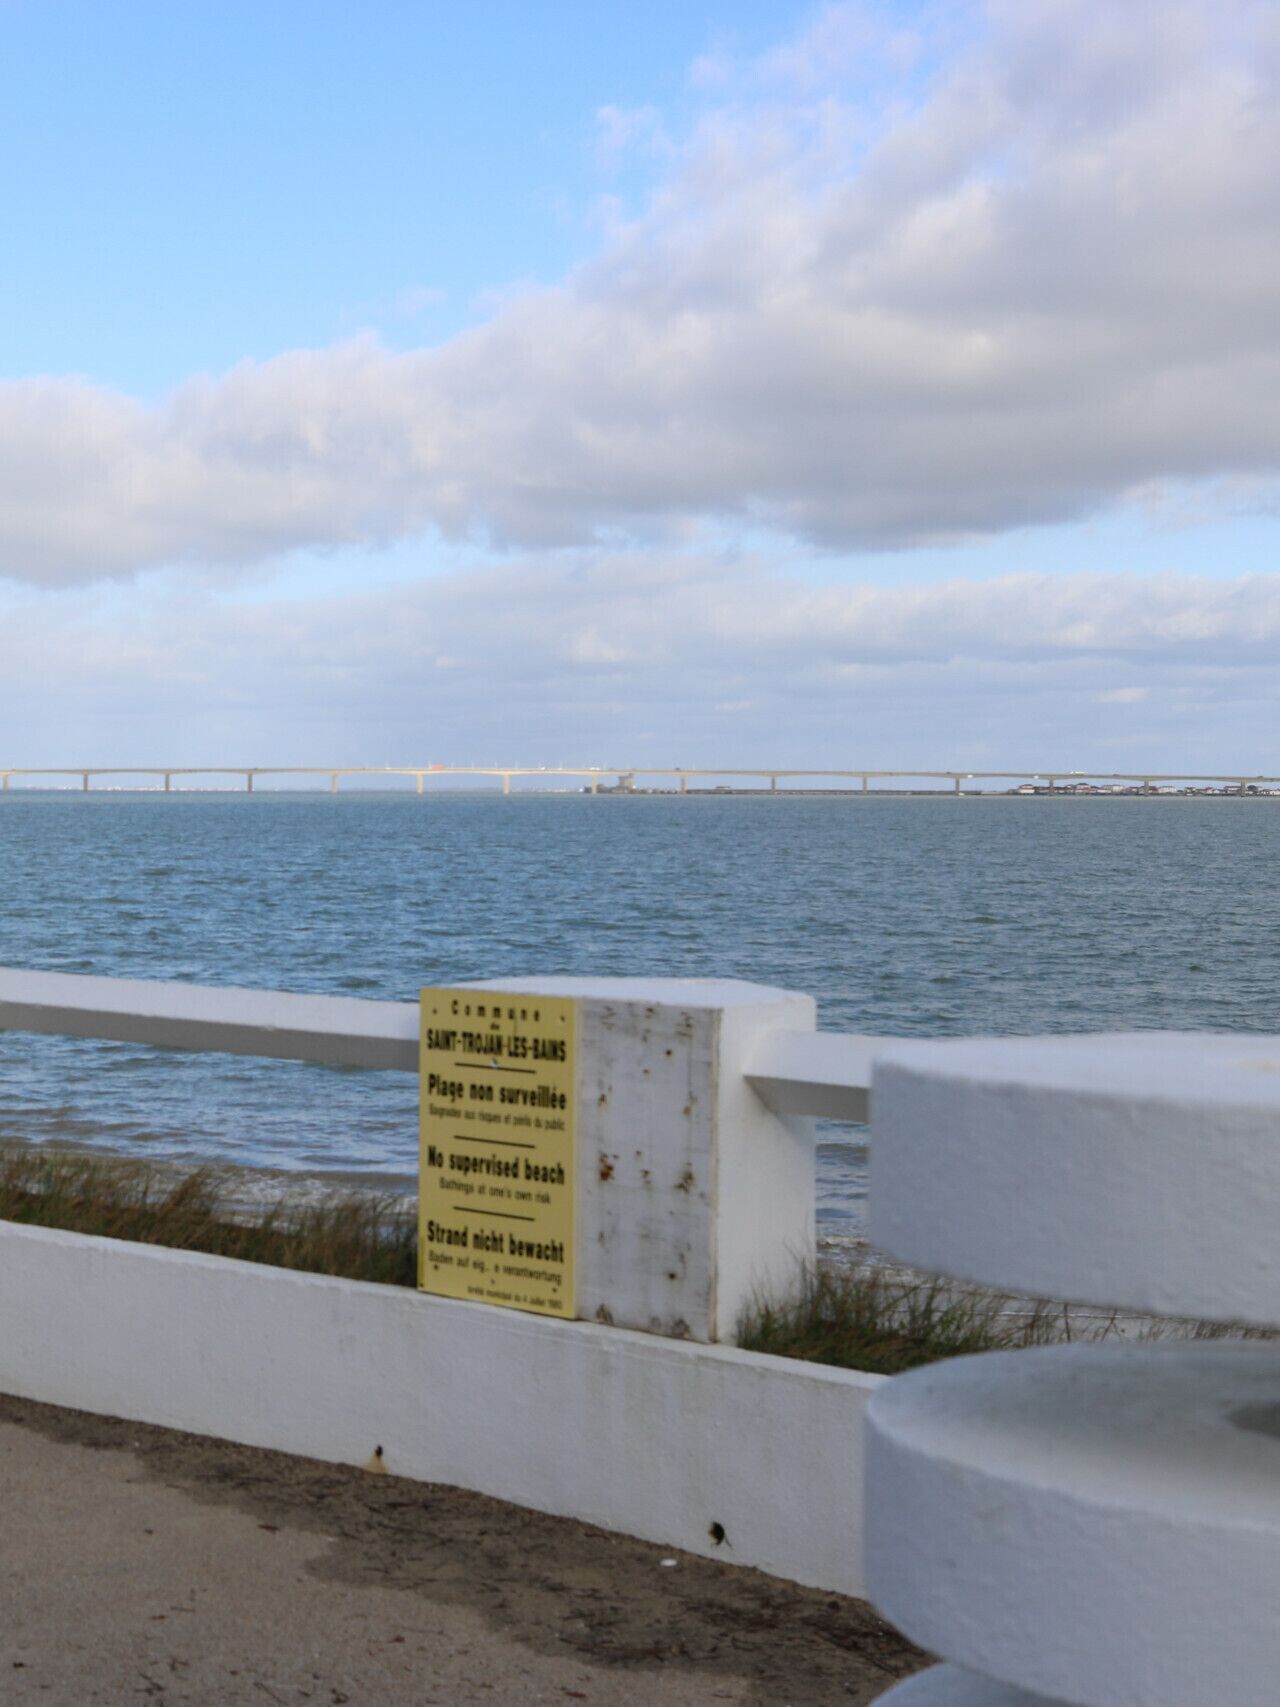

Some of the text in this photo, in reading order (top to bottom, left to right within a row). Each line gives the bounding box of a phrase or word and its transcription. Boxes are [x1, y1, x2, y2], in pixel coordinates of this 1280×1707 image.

[451, 999, 540, 1022] Commune
[428, 1073, 566, 1110] Plage non surveillée
[428, 1145, 565, 1185] No supervised beach
[428, 1220, 565, 1263] Strand nicht bewacht
